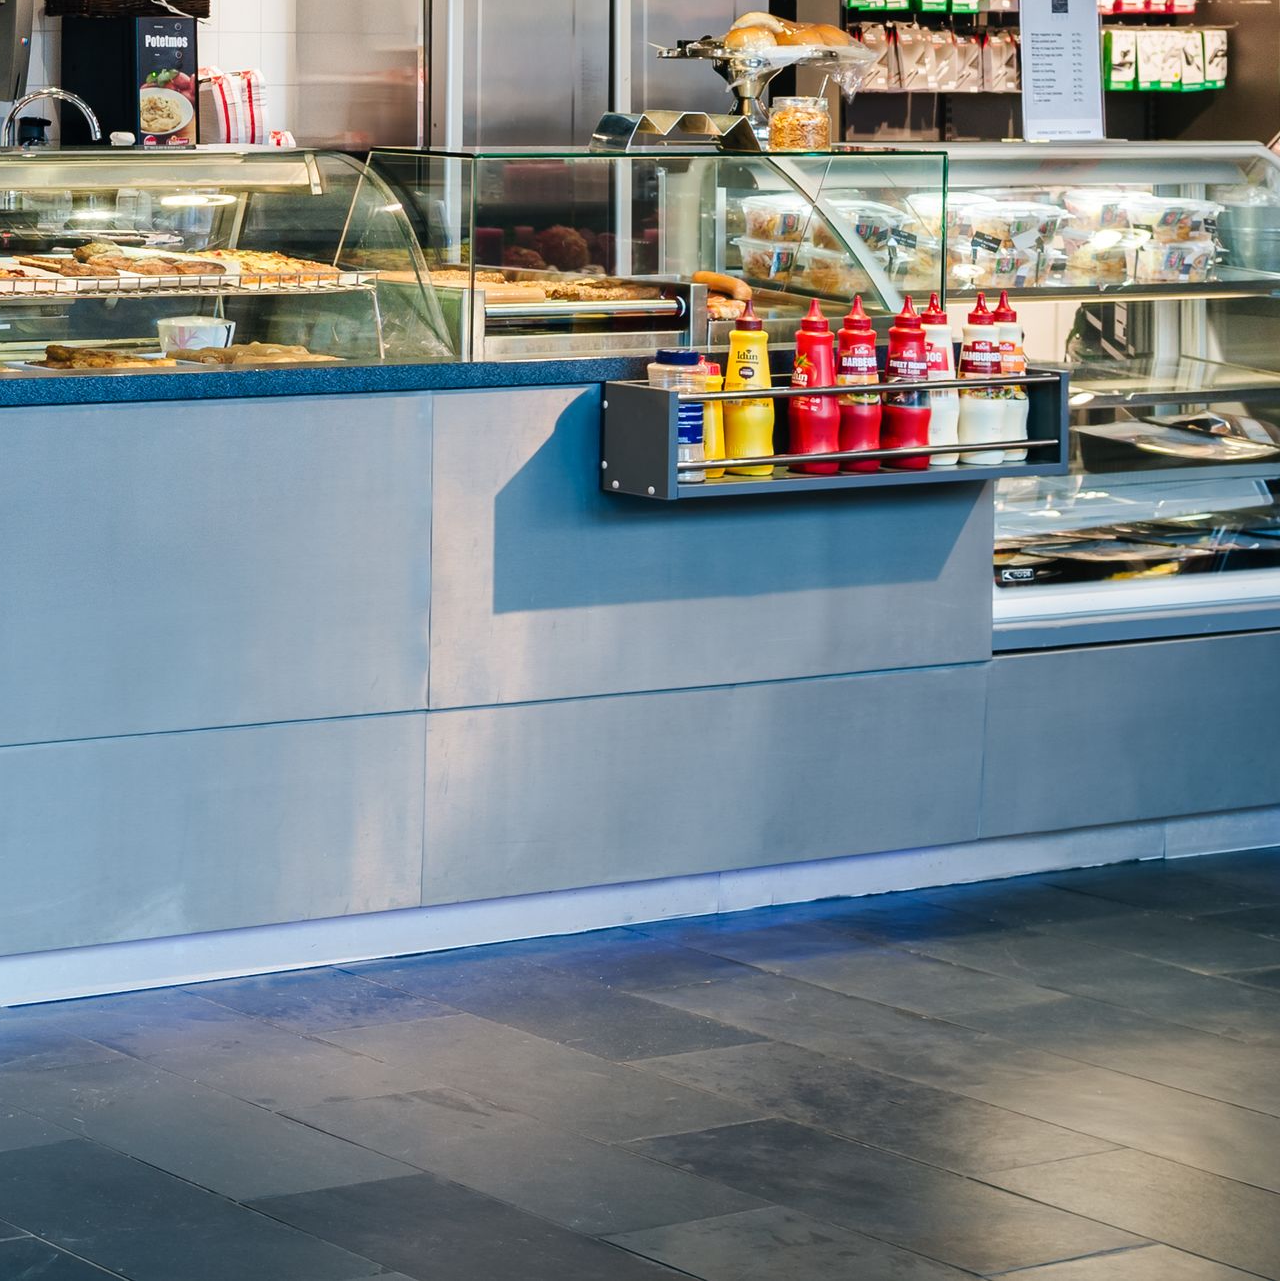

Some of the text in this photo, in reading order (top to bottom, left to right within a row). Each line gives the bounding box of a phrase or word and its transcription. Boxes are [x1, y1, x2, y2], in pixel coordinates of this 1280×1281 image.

[145, 34, 188, 48] Potetmos
[737, 349, 758, 360] Idun
[792, 367, 808, 381] dun
